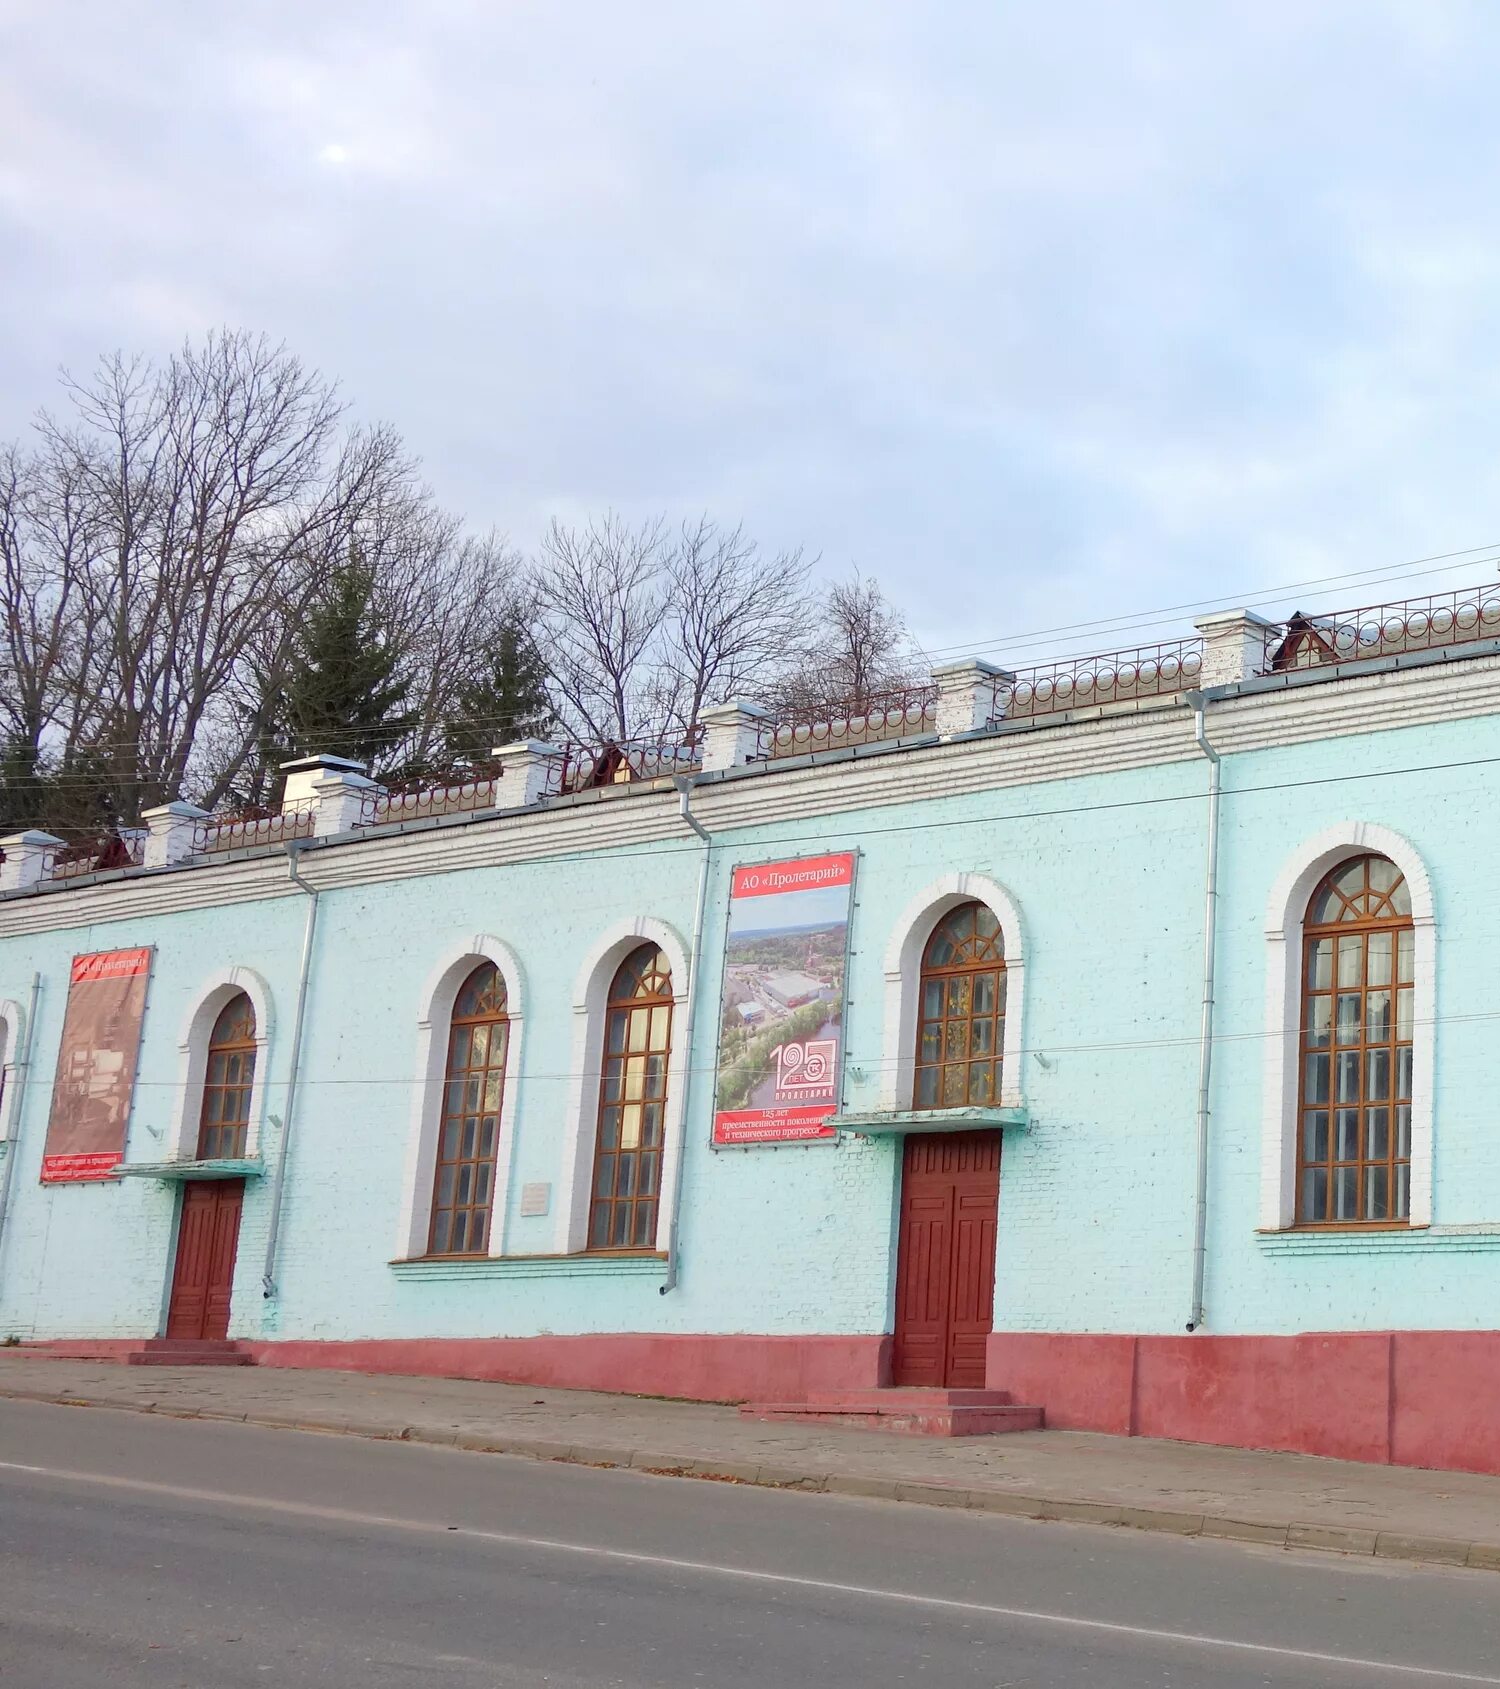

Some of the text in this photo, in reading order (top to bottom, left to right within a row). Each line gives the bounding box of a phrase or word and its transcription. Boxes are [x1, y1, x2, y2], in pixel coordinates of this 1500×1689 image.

[741, 863, 845, 889] АО «Пролетарий»
[770, 1040, 836, 1090] 125
[775, 1088, 833, 1100] ПРОЛЕТАРИЙ
[762, 1109, 789, 1118] 125 лет
[722, 1114, 827, 1131] преемственности поколени
[732, 1128, 780, 1138] технического
[782, 1126, 820, 1137] прогресса
